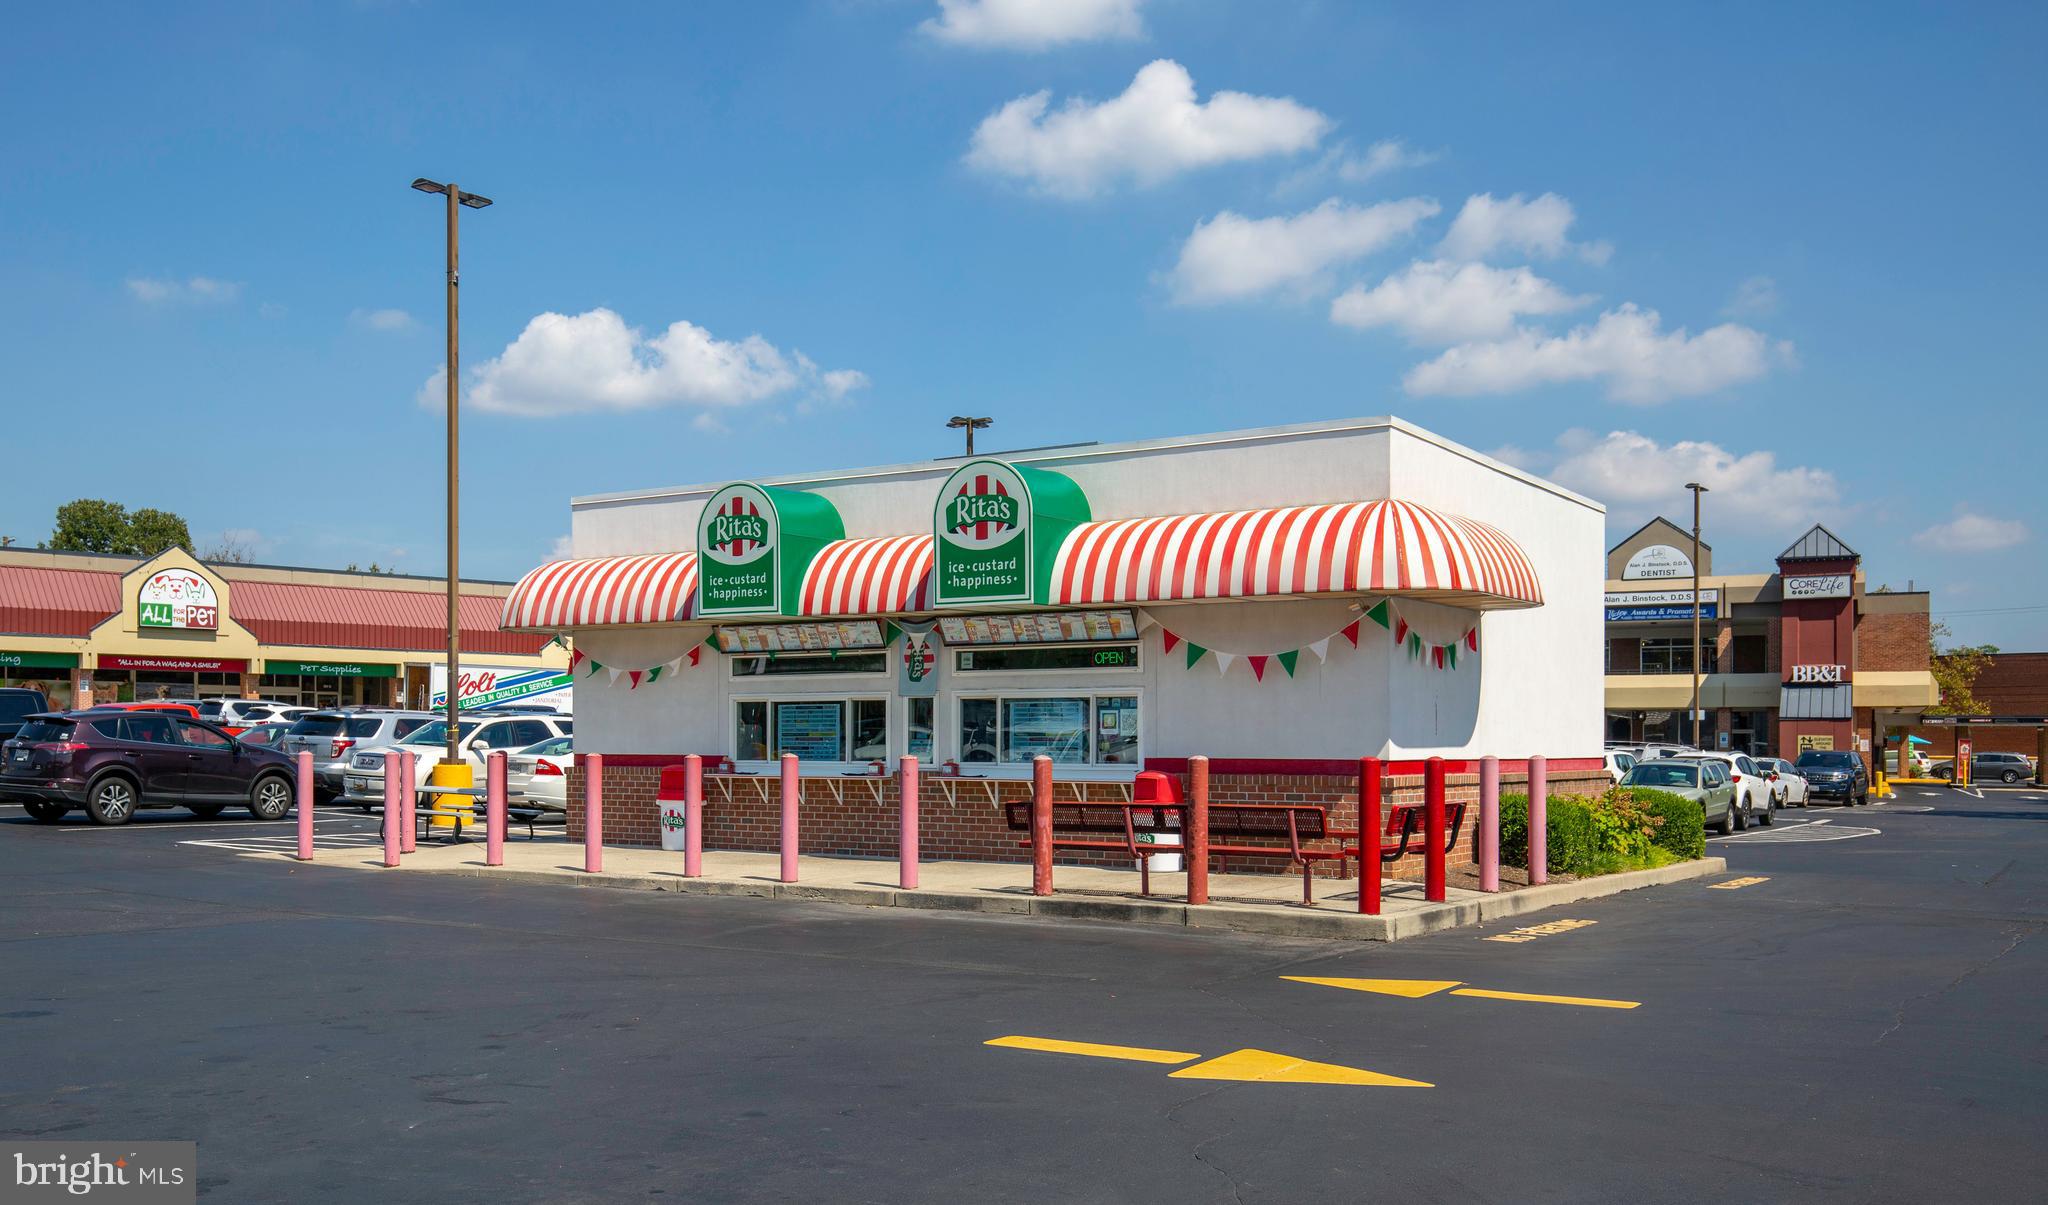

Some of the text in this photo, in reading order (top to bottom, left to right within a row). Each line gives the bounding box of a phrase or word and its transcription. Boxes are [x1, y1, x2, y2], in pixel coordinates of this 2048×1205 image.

[956, 496, 1011, 524] Rita's
[716, 516, 762, 541] Rita's
[949, 557, 1016, 573] ice custard
[1641, 569, 1677, 577] DENTIST
[709, 572, 766, 586] ice custard
[1632, 594, 1667, 602] Binstock,
[1670, 593, 1694, 601] D.D.S.
[143, 604, 171, 623] ALL
[1095, 651, 1124, 664] OPEN
[320, 664, 362, 675] Supplies
[1791, 665, 1846, 682] BB&T
[462, 695, 487, 708] LEADER
[487, 693, 495, 701] IN
[496, 688, 520, 699] QUALITY
[528, 680, 553, 691] SERVICE
